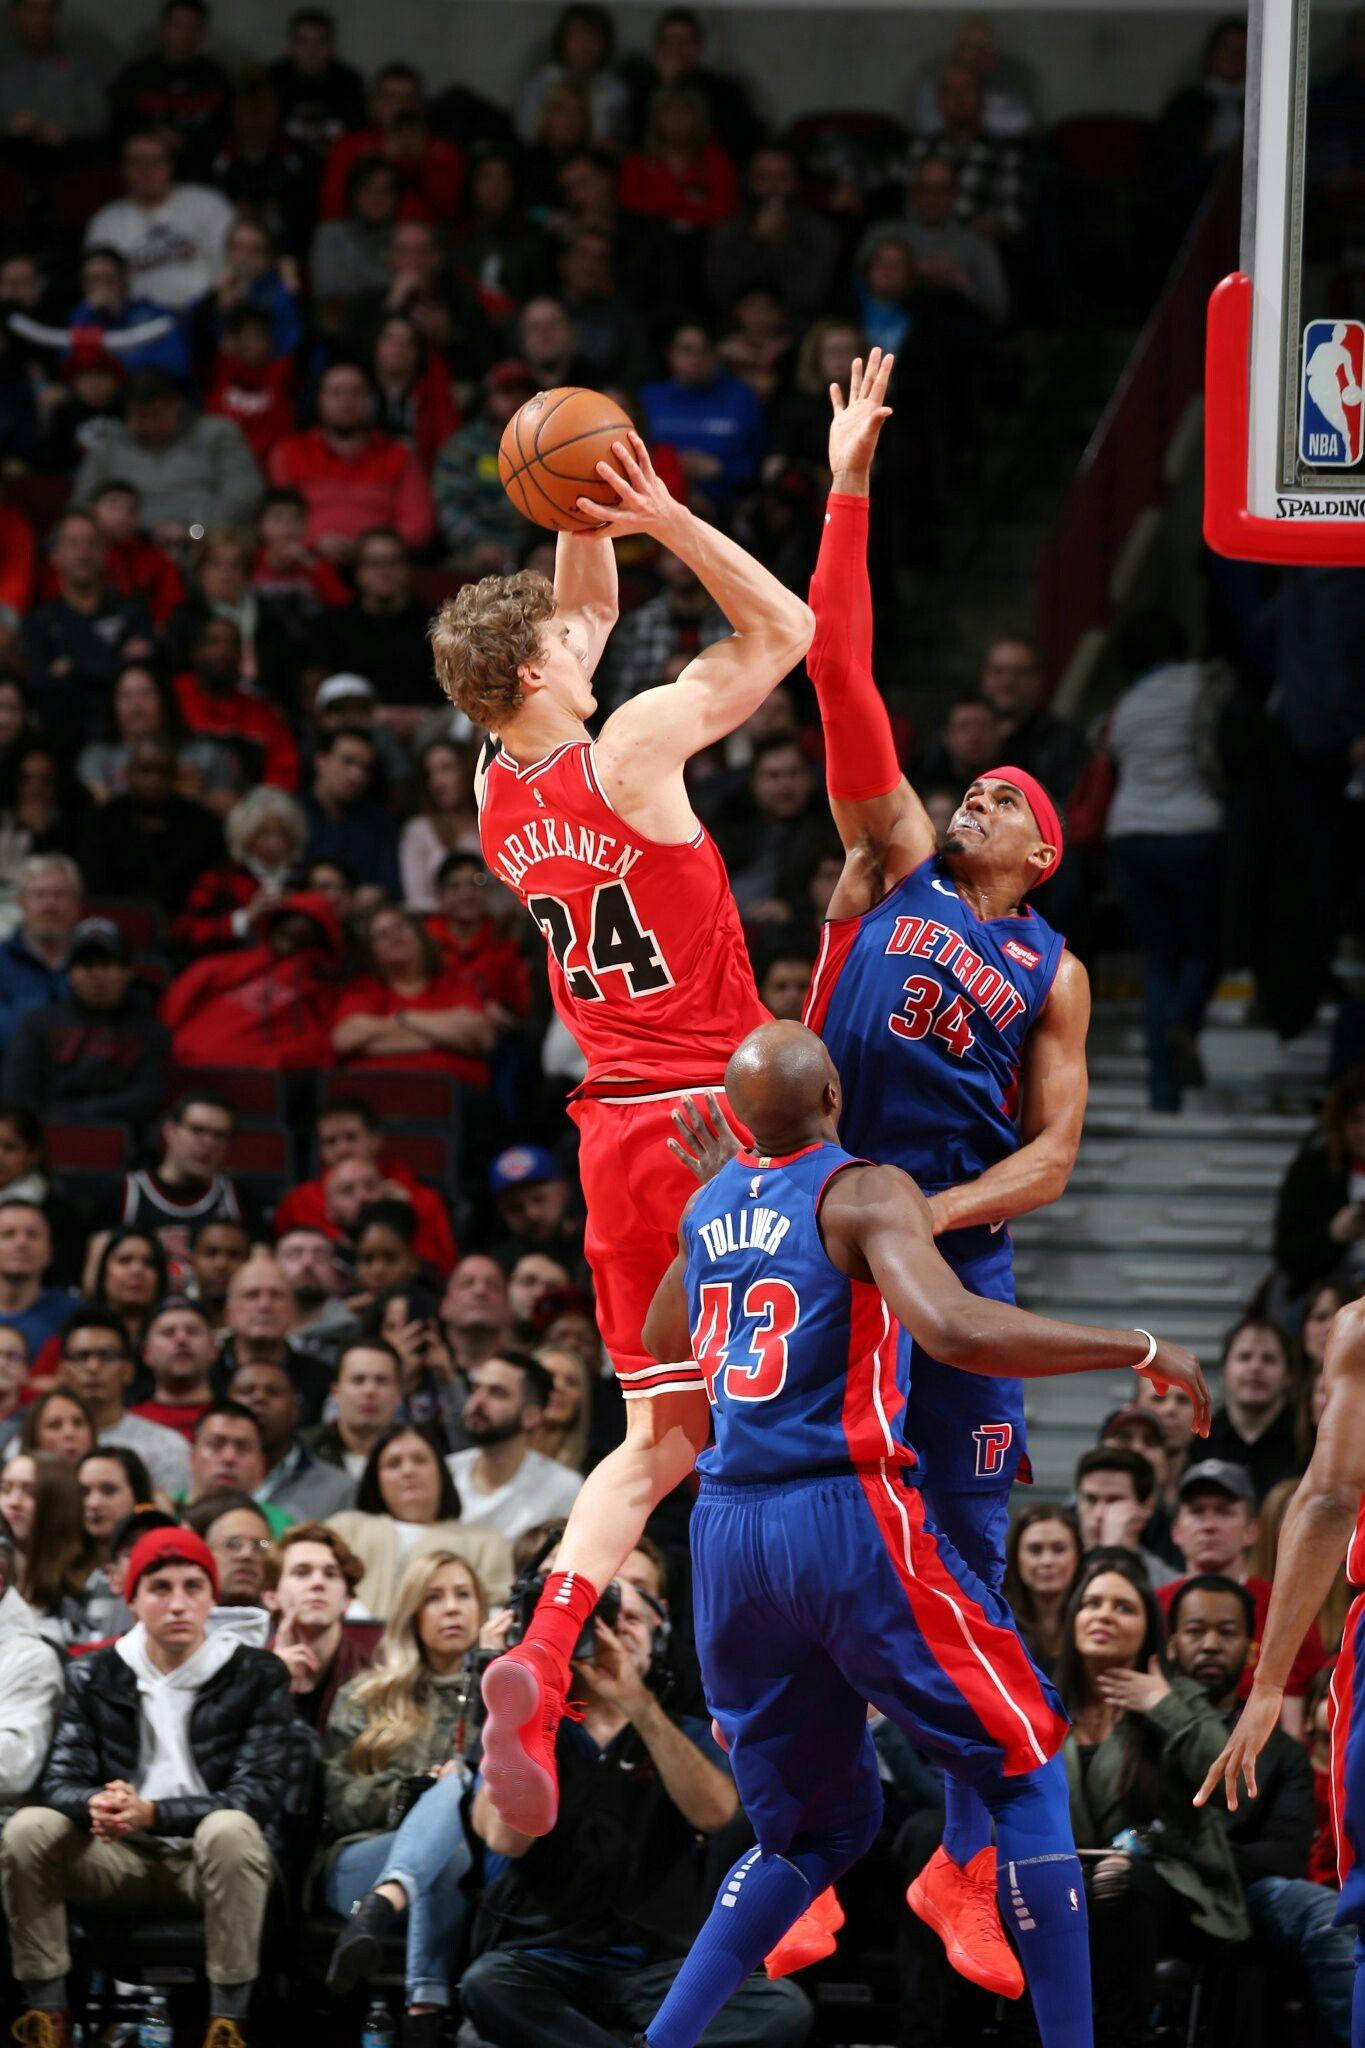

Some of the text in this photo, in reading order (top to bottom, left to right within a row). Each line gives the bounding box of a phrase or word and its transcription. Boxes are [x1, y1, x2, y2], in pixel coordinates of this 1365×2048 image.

[1308, 432, 1339, 457] NBA
[494, 817, 643, 896] ARKKANEN
[526, 877, 677, 1003] 24
[884, 915, 1027, 1032] DETROIT
[887, 974, 976, 1059] 34
[697, 1207, 791, 1263] TOLLIVER
[691, 1277, 800, 1406] 43
